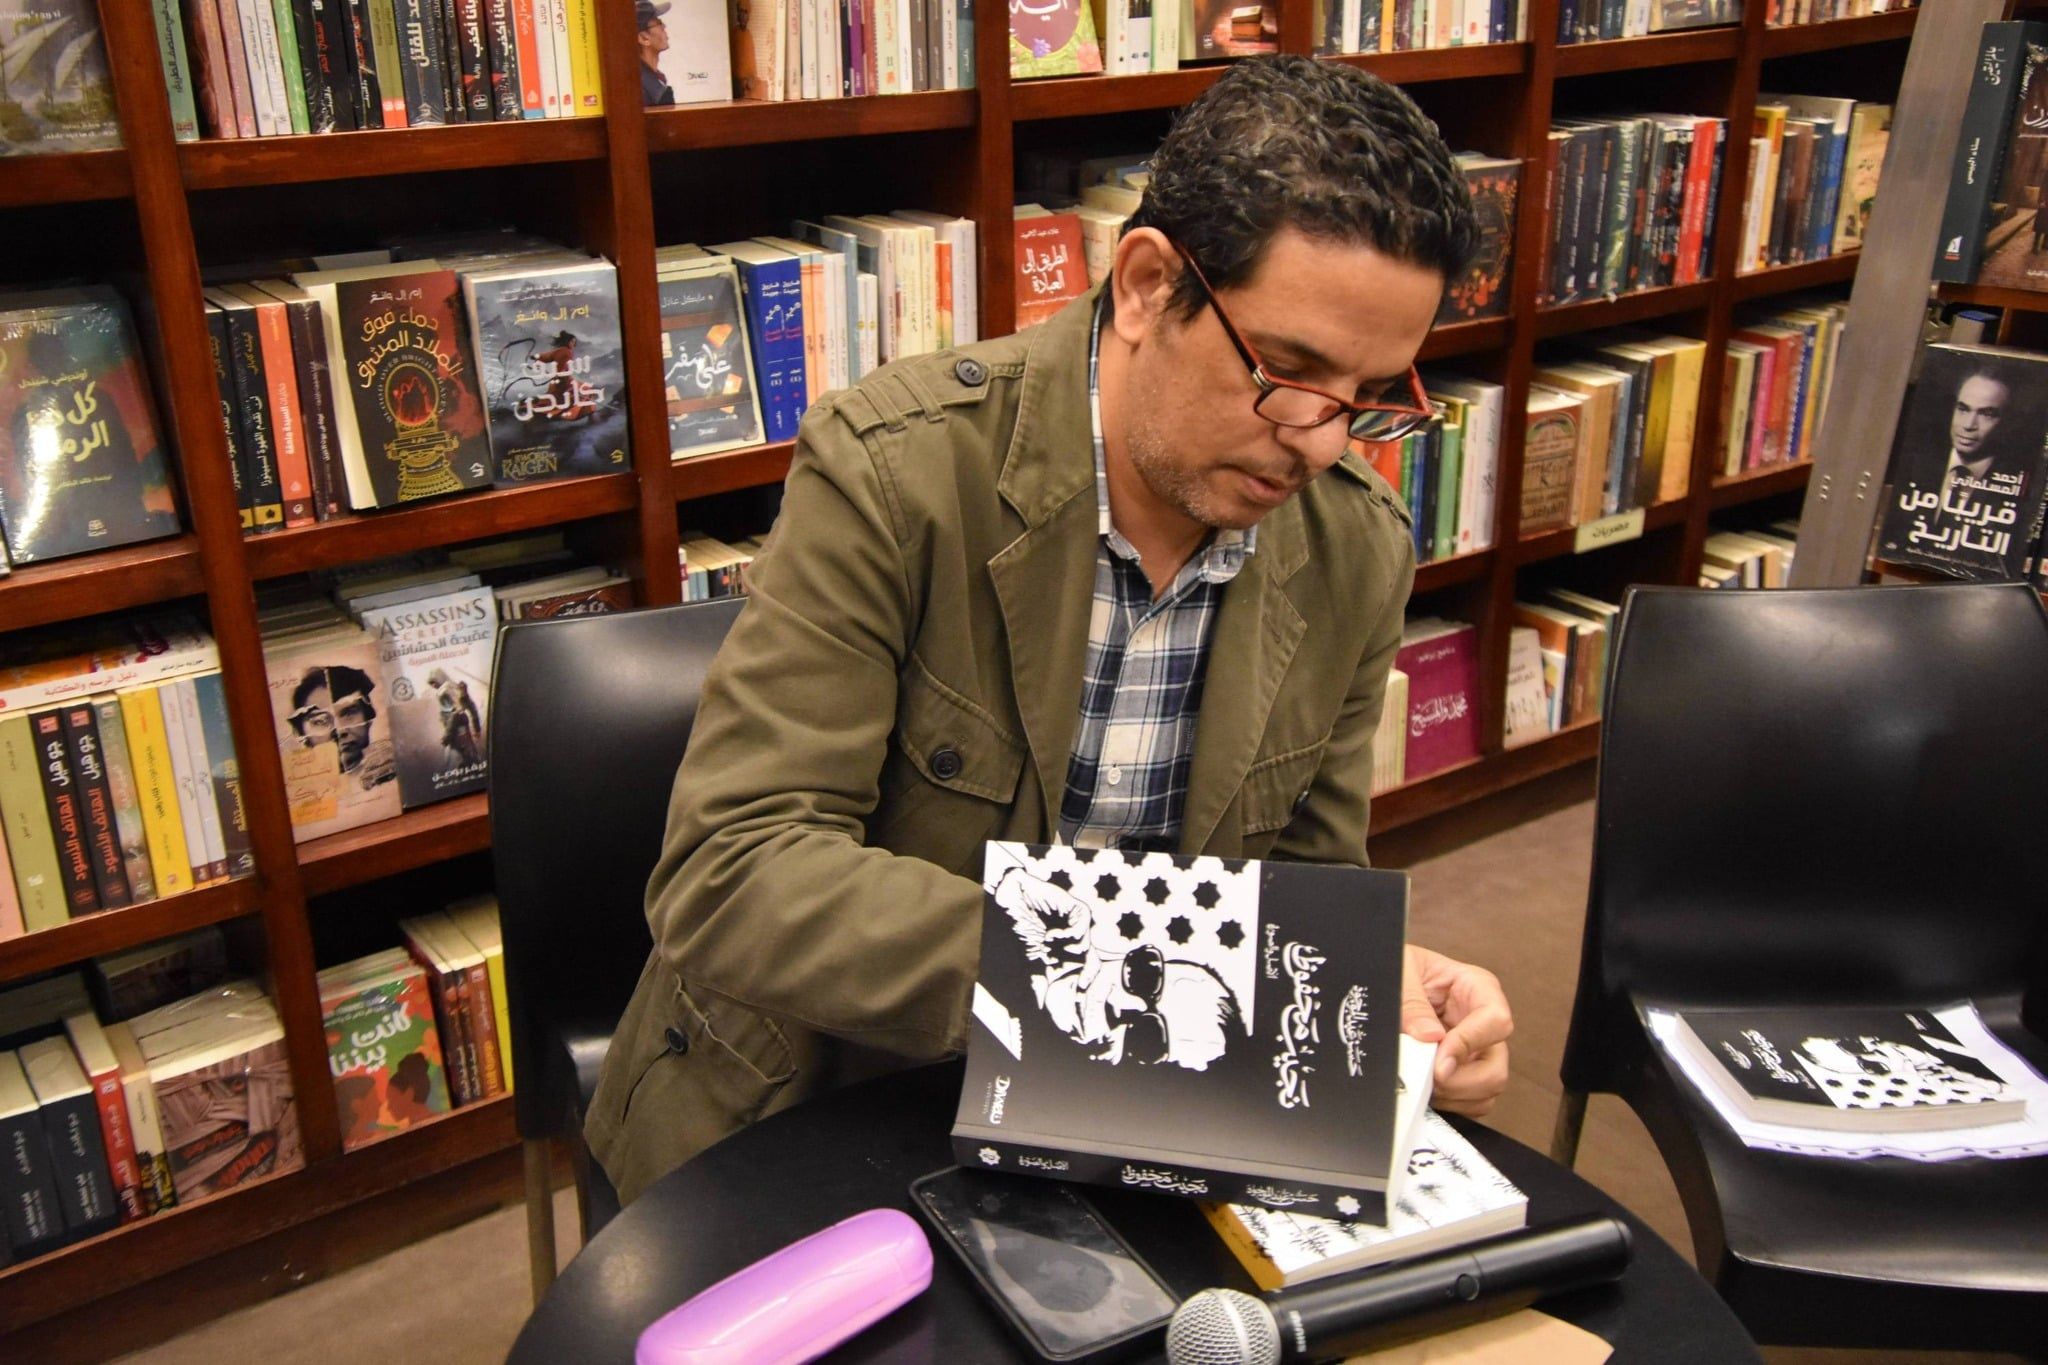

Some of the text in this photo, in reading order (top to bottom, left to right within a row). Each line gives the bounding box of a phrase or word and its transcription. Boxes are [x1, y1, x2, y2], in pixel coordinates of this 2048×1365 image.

[360, 307, 439, 342] دماء فوق
[412, 332, 464, 376] الملاذ
[521, 353, 591, 384] سيف
[66, 380, 97, 425] كل
[511, 379, 605, 422] كايجن
[502, 455, 557, 481] KAIGEN
[1991, 471, 2024, 485] أحمد
[1899, 481, 1940, 512] من
[1950, 475, 2020, 497] المسلماني
[1908, 514, 2012, 556] التاريخ
[379, 597, 487, 641] ASSASSIN'S
[401, 622, 465, 643] CREED
[382, 628, 492, 663] عقيدة الحشاشين
[50, 759, 71, 787] هيل
[82, 753, 101, 781] هيل
[56, 793, 88, 881] الهاتف الأسود
[87, 787, 119, 874] الهاتف الأسود
[1282, 941, 1328, 1042] محفوظ
[350, 1000, 412, 1048] كانت
[328, 1044, 387, 1077] بيننا
